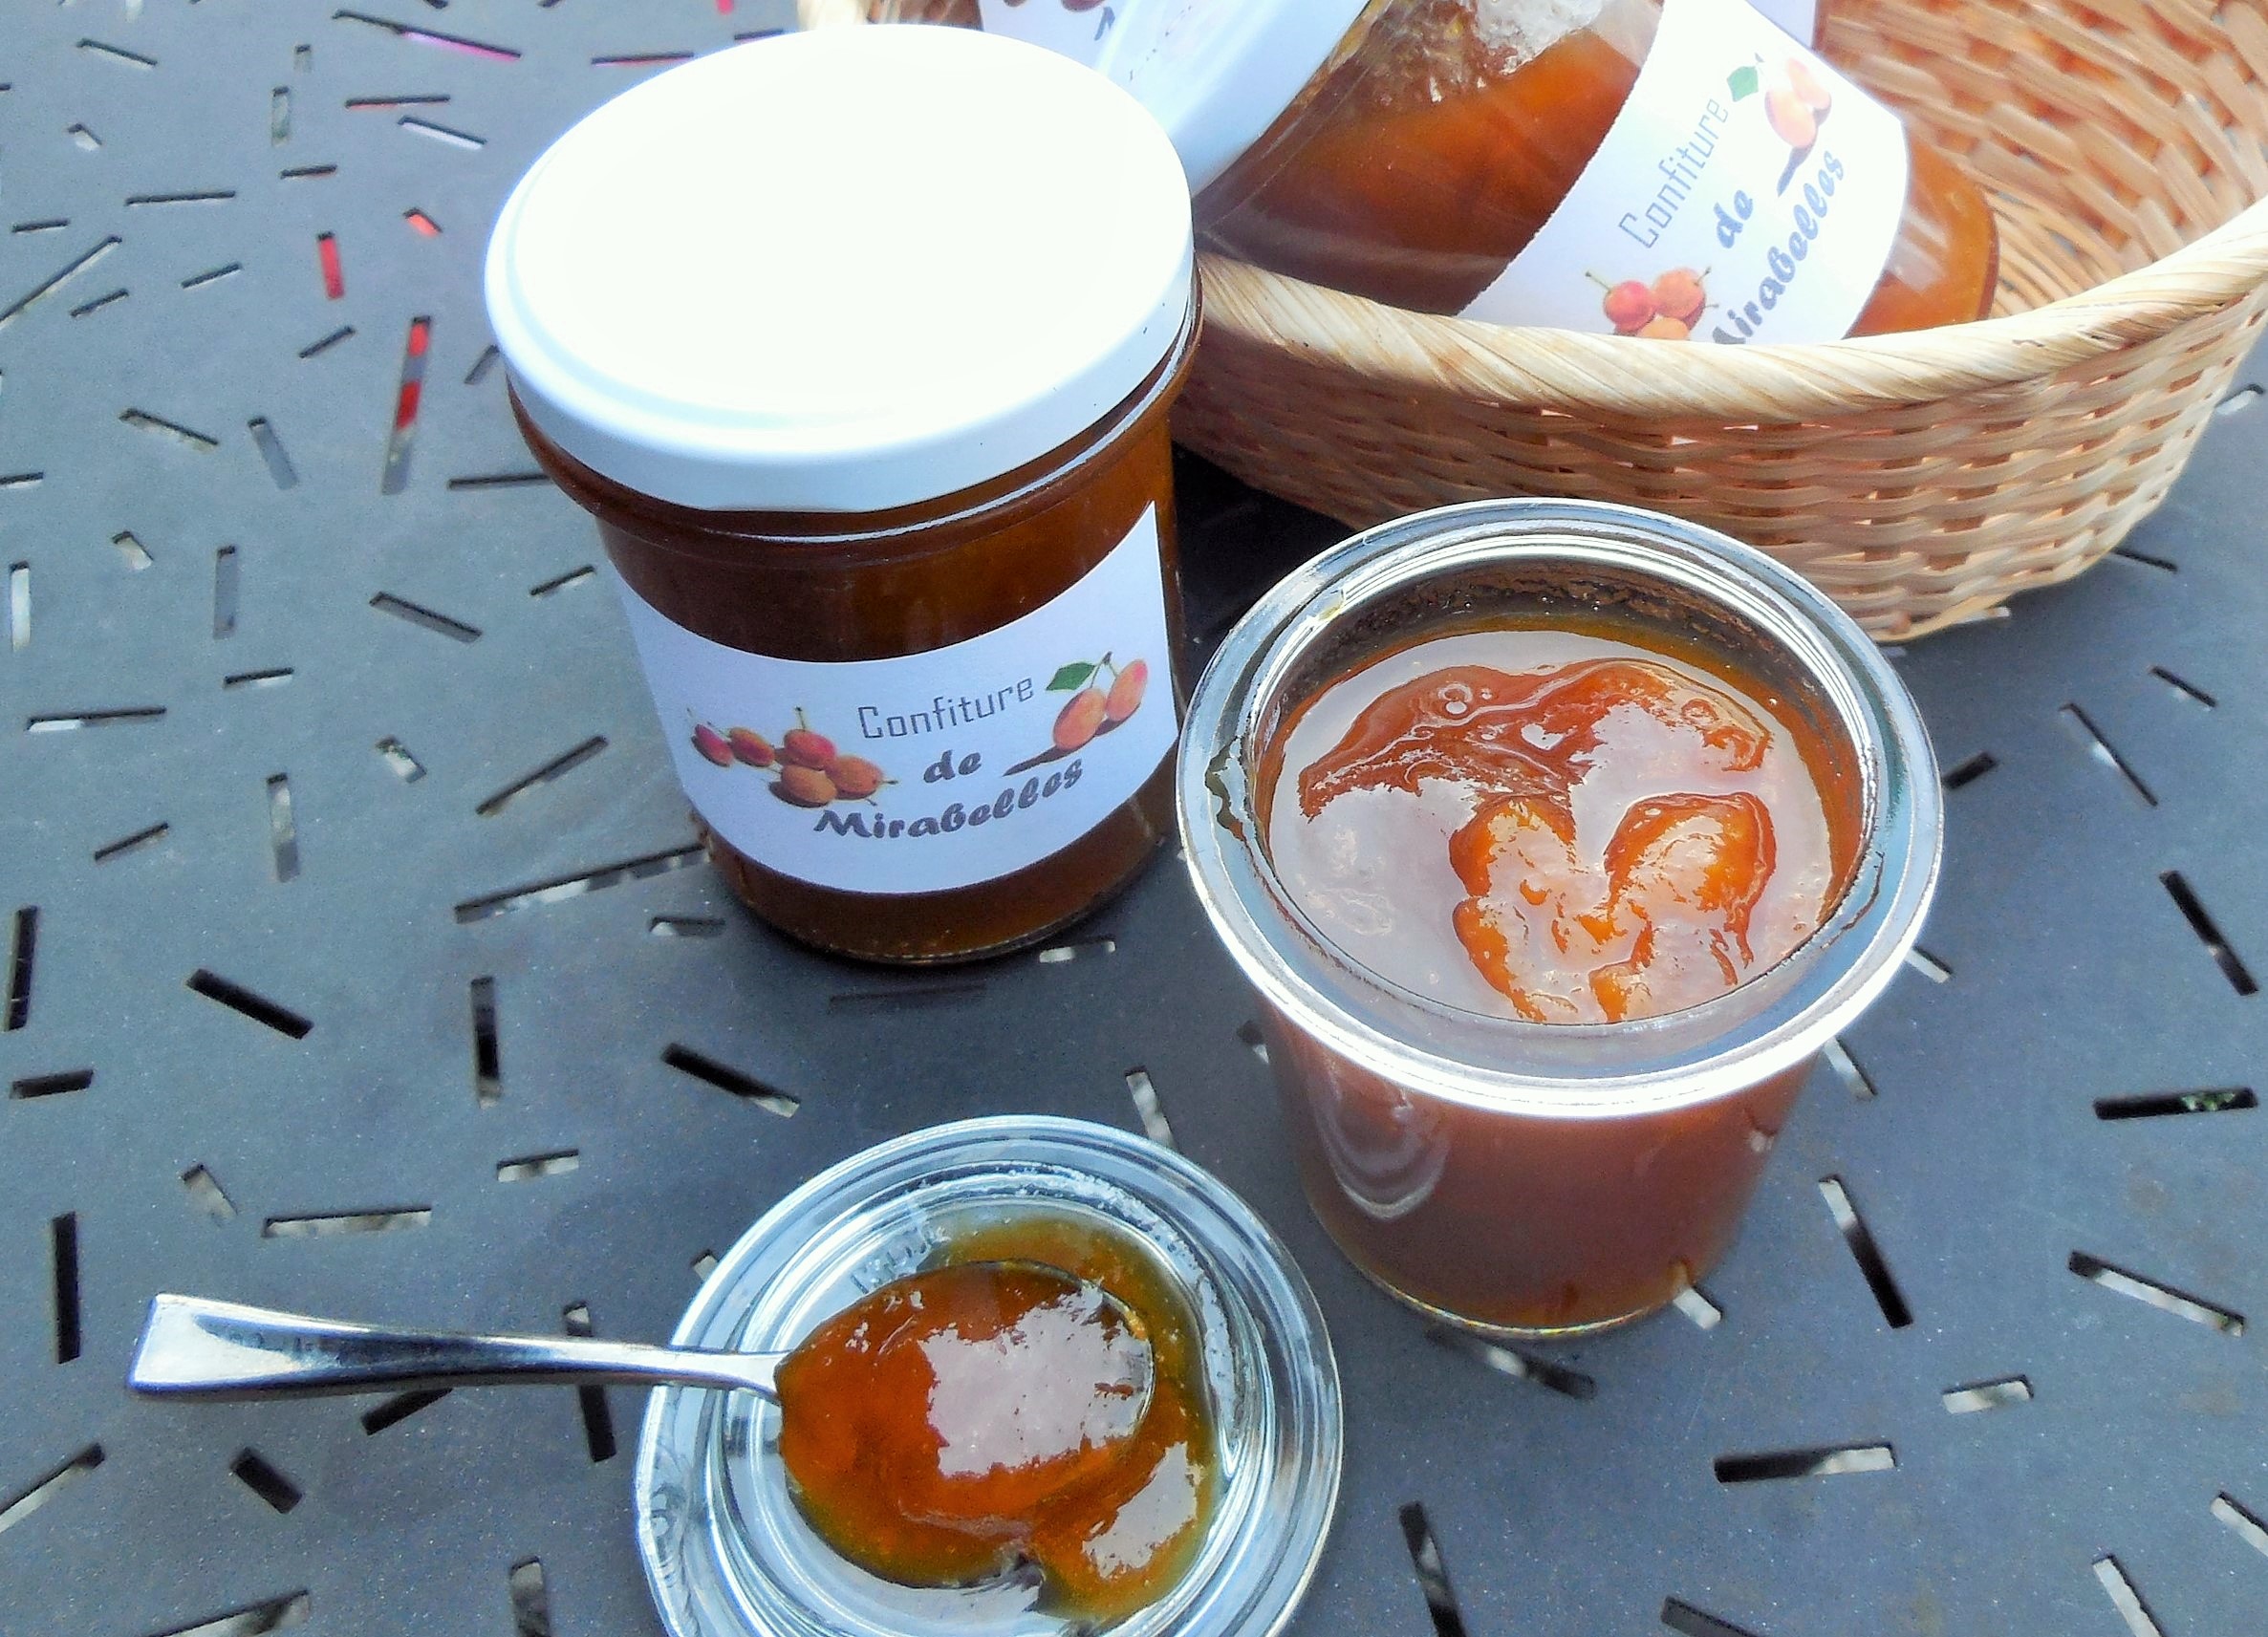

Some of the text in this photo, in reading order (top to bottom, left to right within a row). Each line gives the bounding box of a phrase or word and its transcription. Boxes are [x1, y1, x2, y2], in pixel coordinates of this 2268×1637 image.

[1618, 98, 1729, 248] Confiture
[1715, 190, 1754, 249] de
[858, 678, 1033, 739] Confiture
[924, 750, 982, 784] de
[813, 759, 1084, 838] Mirabelles
